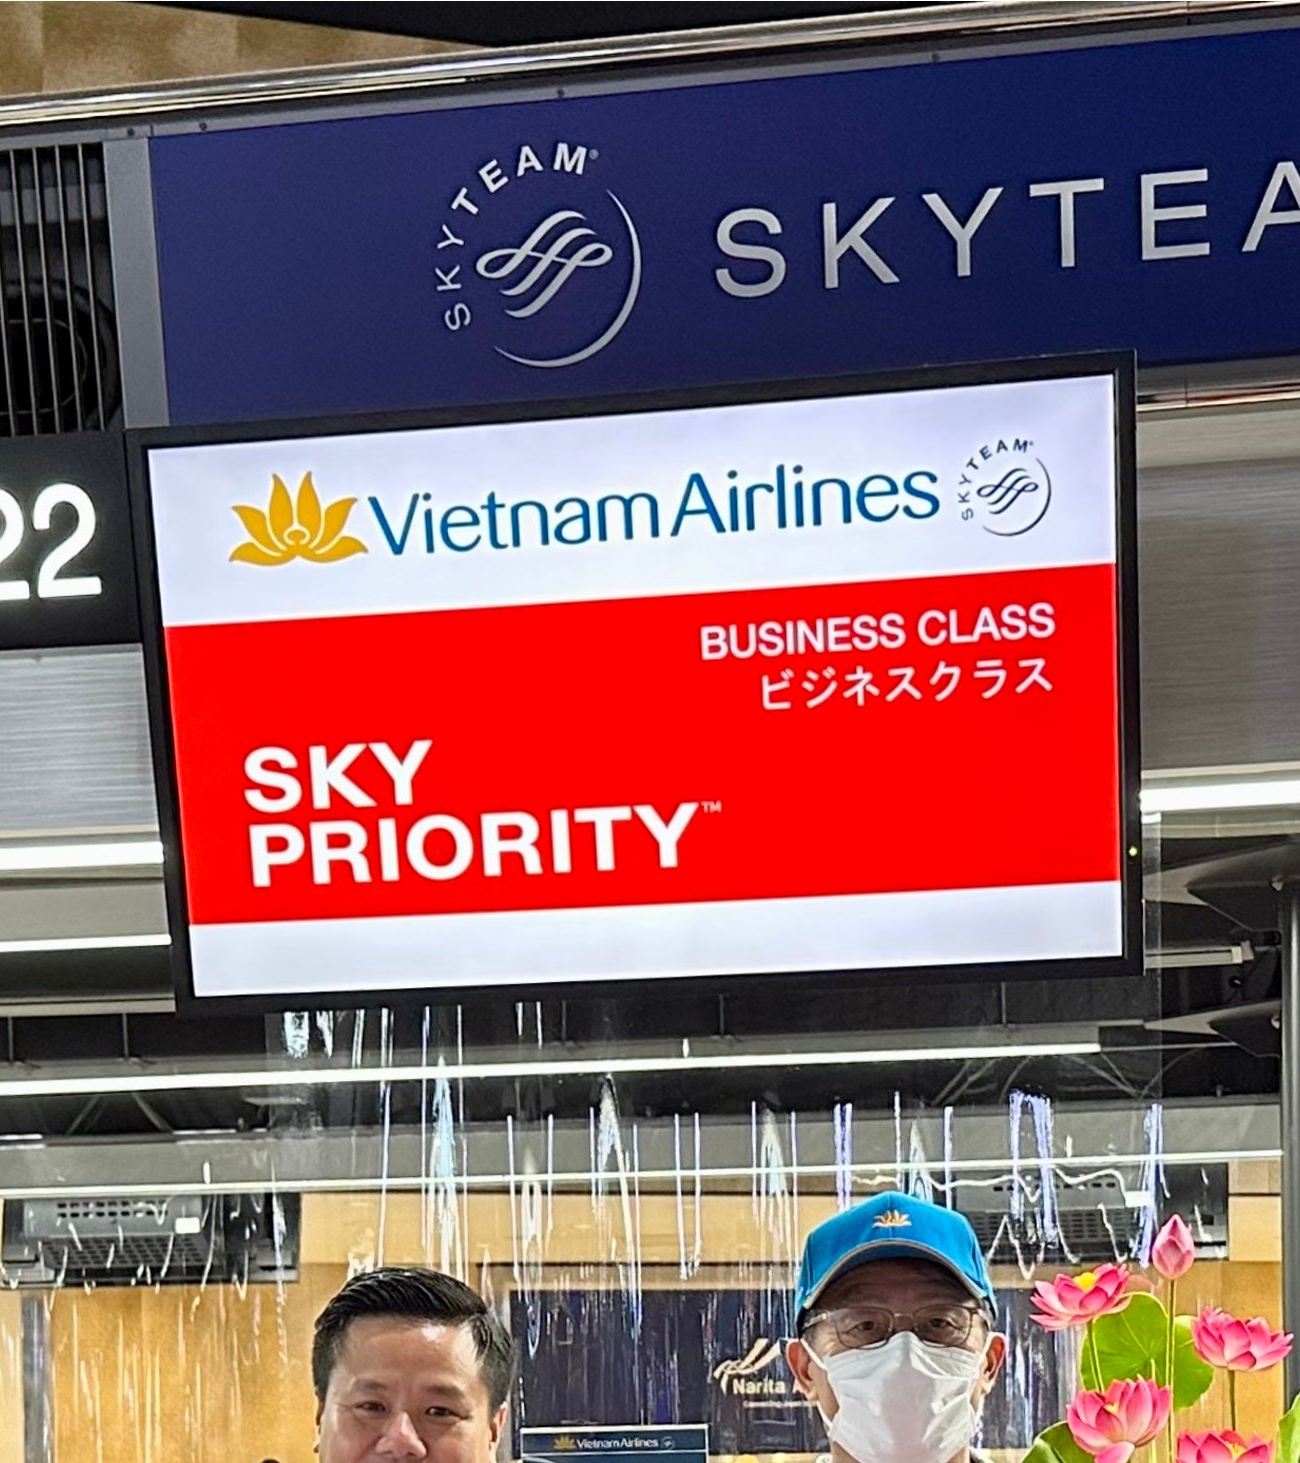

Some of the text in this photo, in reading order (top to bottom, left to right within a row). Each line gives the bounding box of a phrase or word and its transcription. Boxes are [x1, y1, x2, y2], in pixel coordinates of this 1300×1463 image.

[435, 142, 586, 332] SKYTEAM
[701, 601, 1055, 660] BUSINESS CLASS
[761, 655, 1055, 712] ビジネスクラス
[243, 739, 432, 813] SKY
[733, 1378, 786, 1394] Narita
